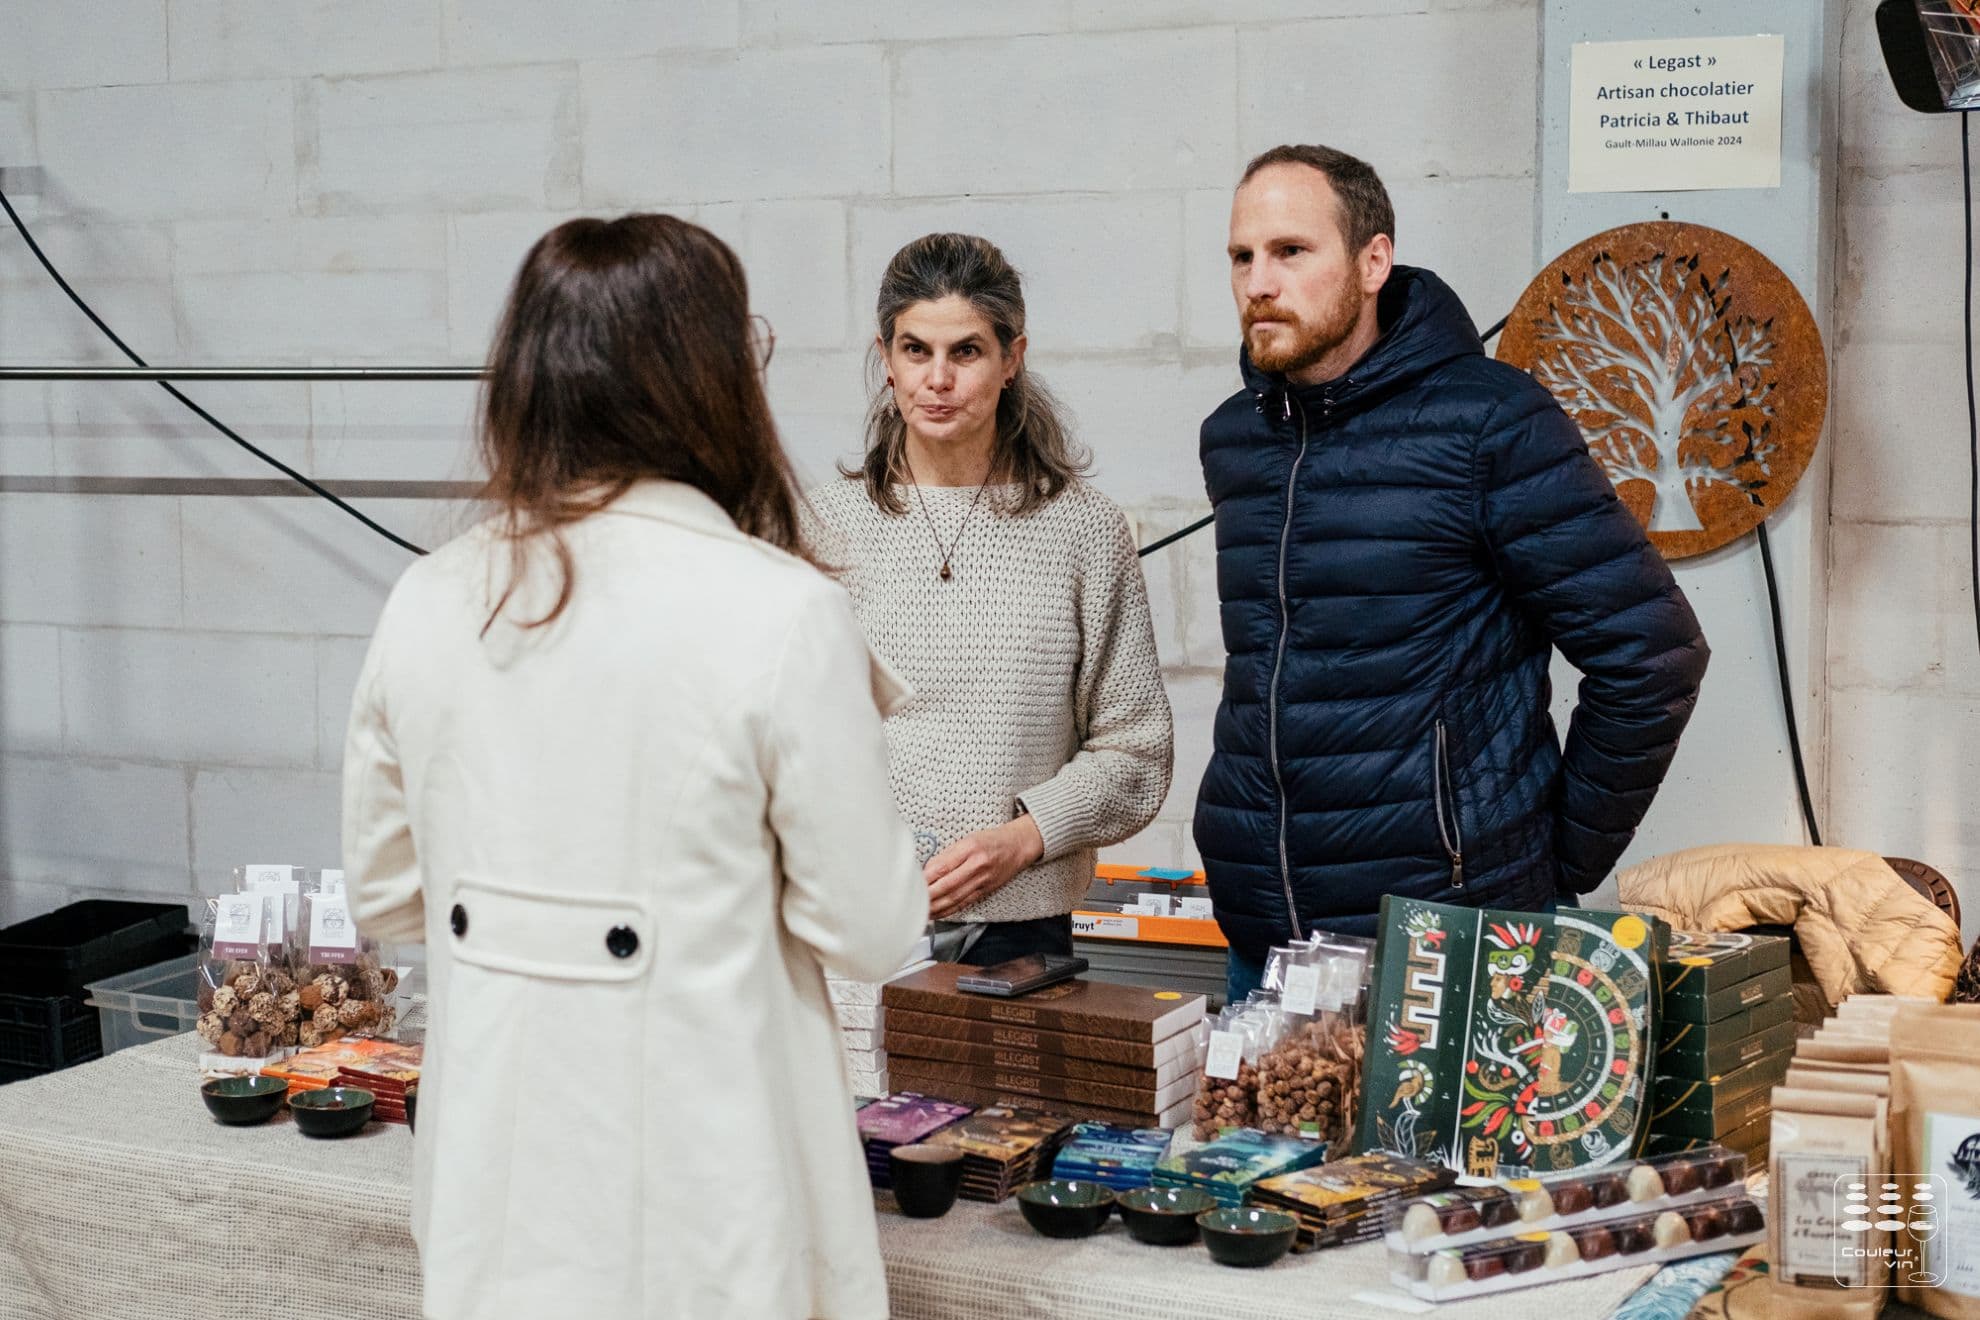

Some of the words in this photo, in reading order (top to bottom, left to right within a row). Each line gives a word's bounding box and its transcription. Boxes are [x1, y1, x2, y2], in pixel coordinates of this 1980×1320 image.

[1649, 55, 1702, 72] Legast
[1597, 85, 1655, 100] Artisan
[1660, 80, 1754, 98] chocolatier
[1600, 112, 1661, 128] Patricia
[1666, 111, 1680, 126] &
[1684, 110, 1750, 125] Thibaut
[1604, 138, 1667, 149] Gault-Millau
[1670, 137, 1715, 147] Wallonie
[1717, 135, 1743, 146] 2024
